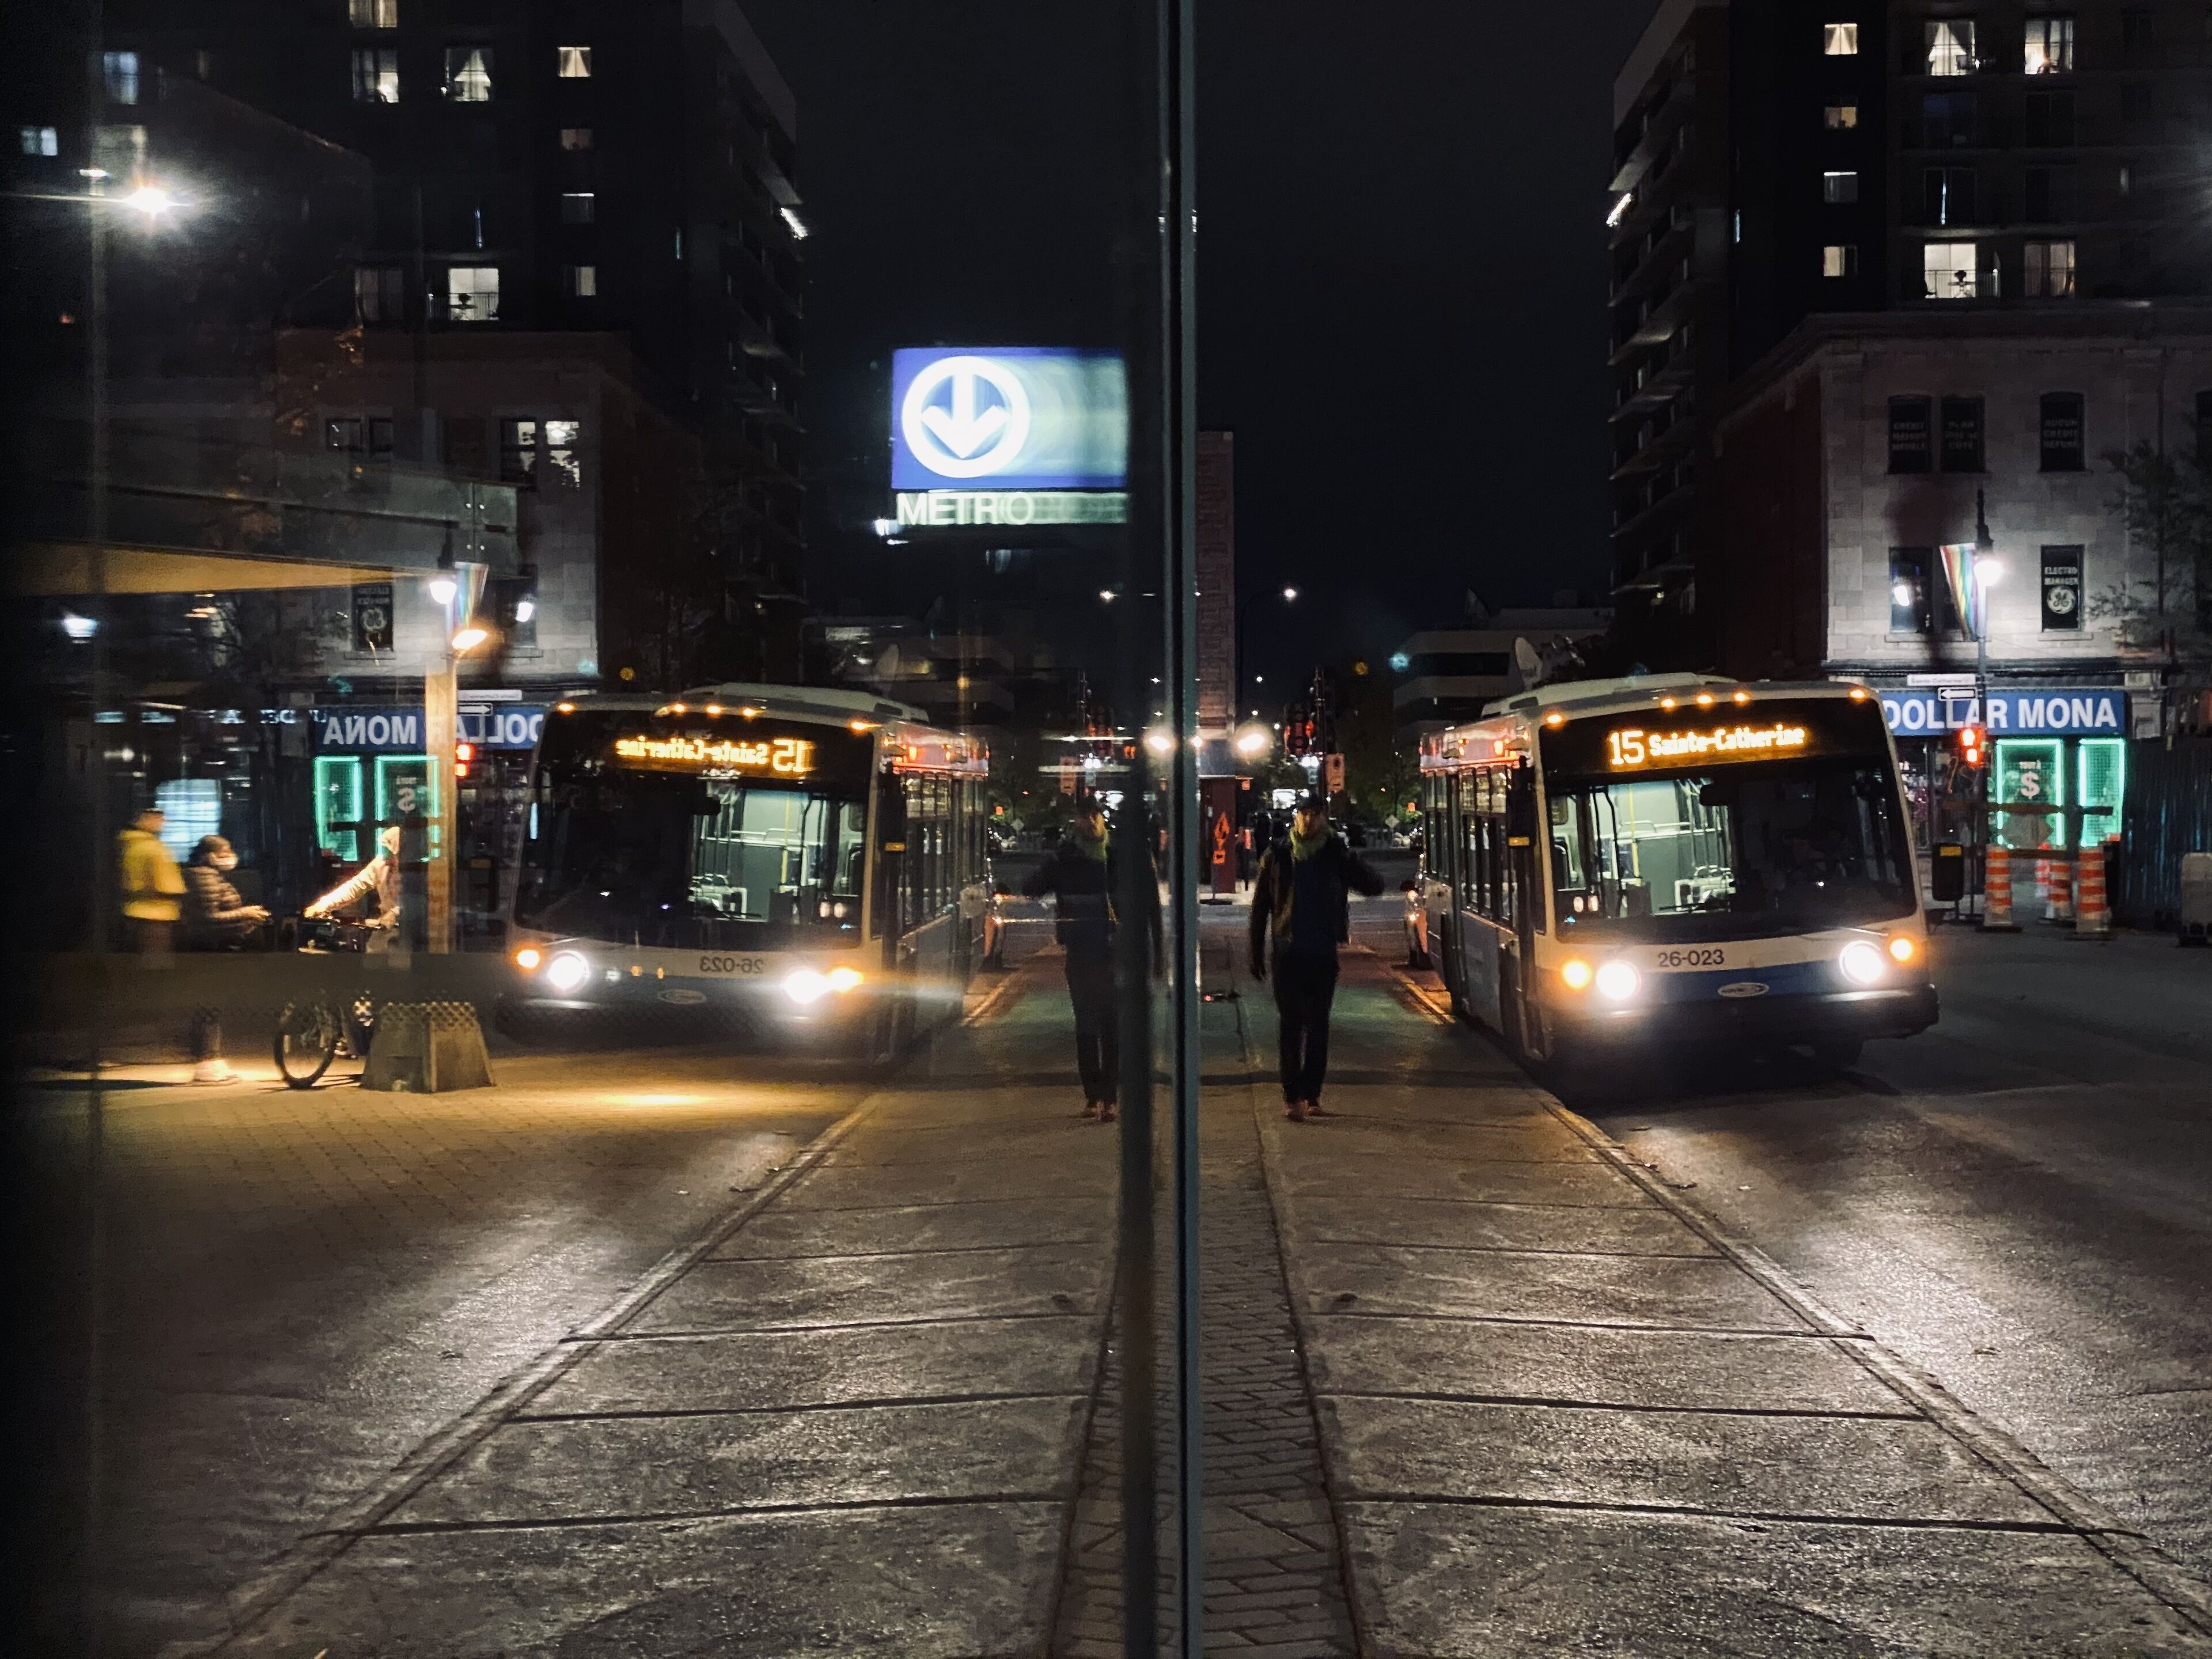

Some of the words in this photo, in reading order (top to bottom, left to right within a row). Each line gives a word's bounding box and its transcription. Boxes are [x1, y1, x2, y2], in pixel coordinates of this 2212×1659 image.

[897, 491, 1035, 525] METRO
[1882, 698, 2008, 730] DOLLAR
[2018, 698, 2118, 729] MONA
[1610, 730, 1645, 766] 15
[1649, 724, 1806, 756] Sainte-Catherine
[1658, 949, 1724, 968] 26-023
